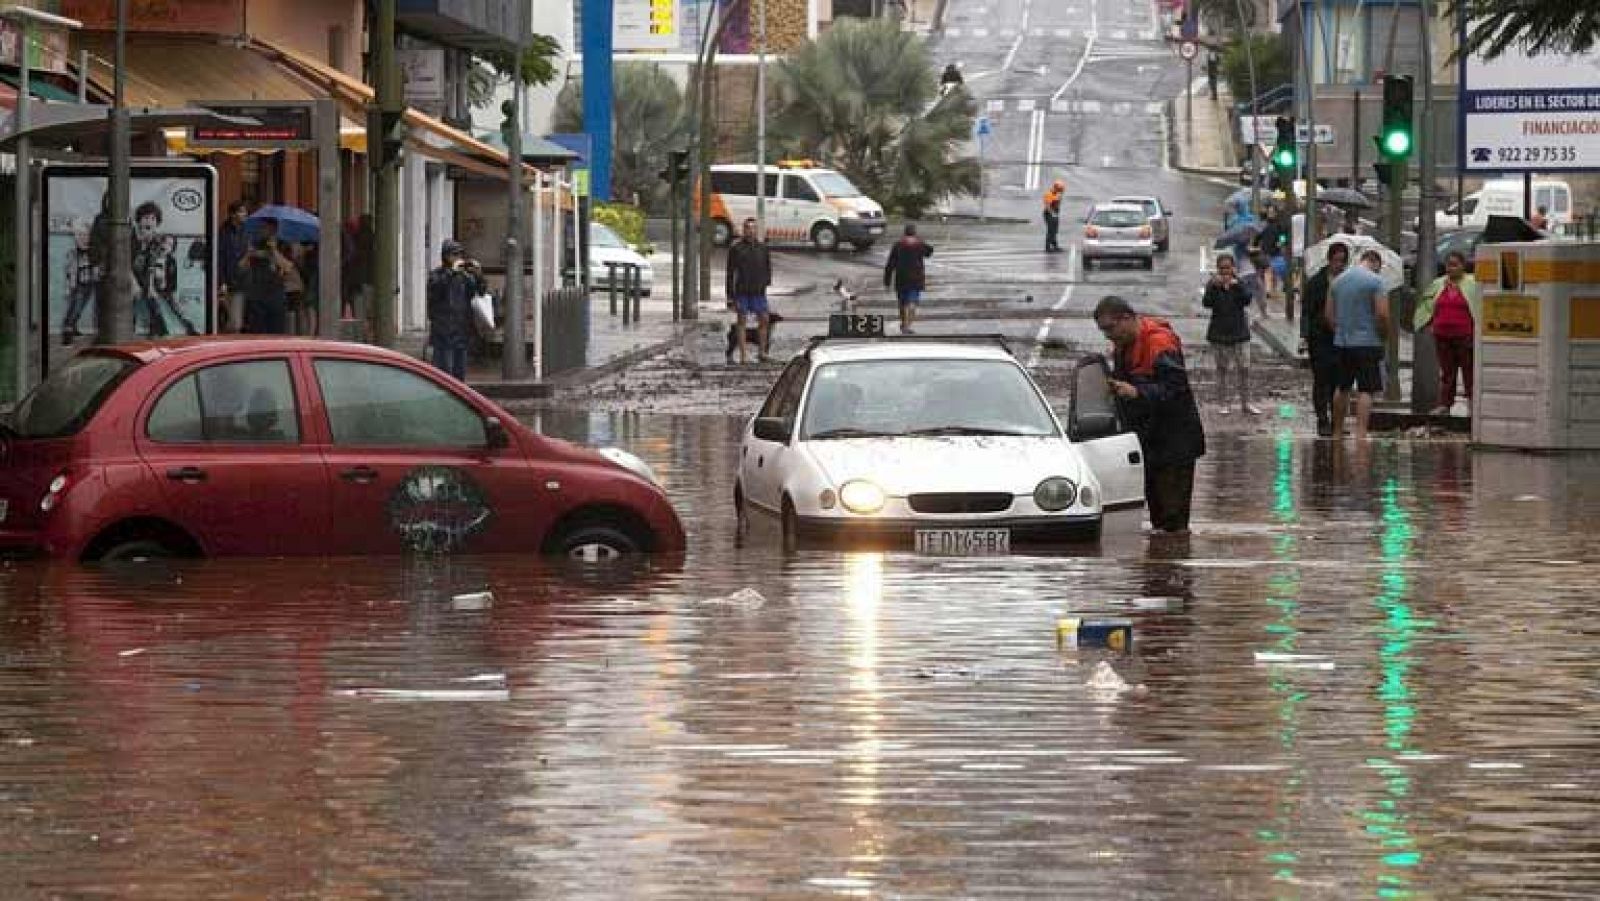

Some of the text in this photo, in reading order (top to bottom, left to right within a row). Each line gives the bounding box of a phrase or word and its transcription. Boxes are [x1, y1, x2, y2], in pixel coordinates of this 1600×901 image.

[1518, 95, 1532, 109] EN
[1535, 95, 1545, 108] EL
[1547, 94, 1586, 108] SECTOR
[1498, 146, 1576, 161] 922 29 75 35
